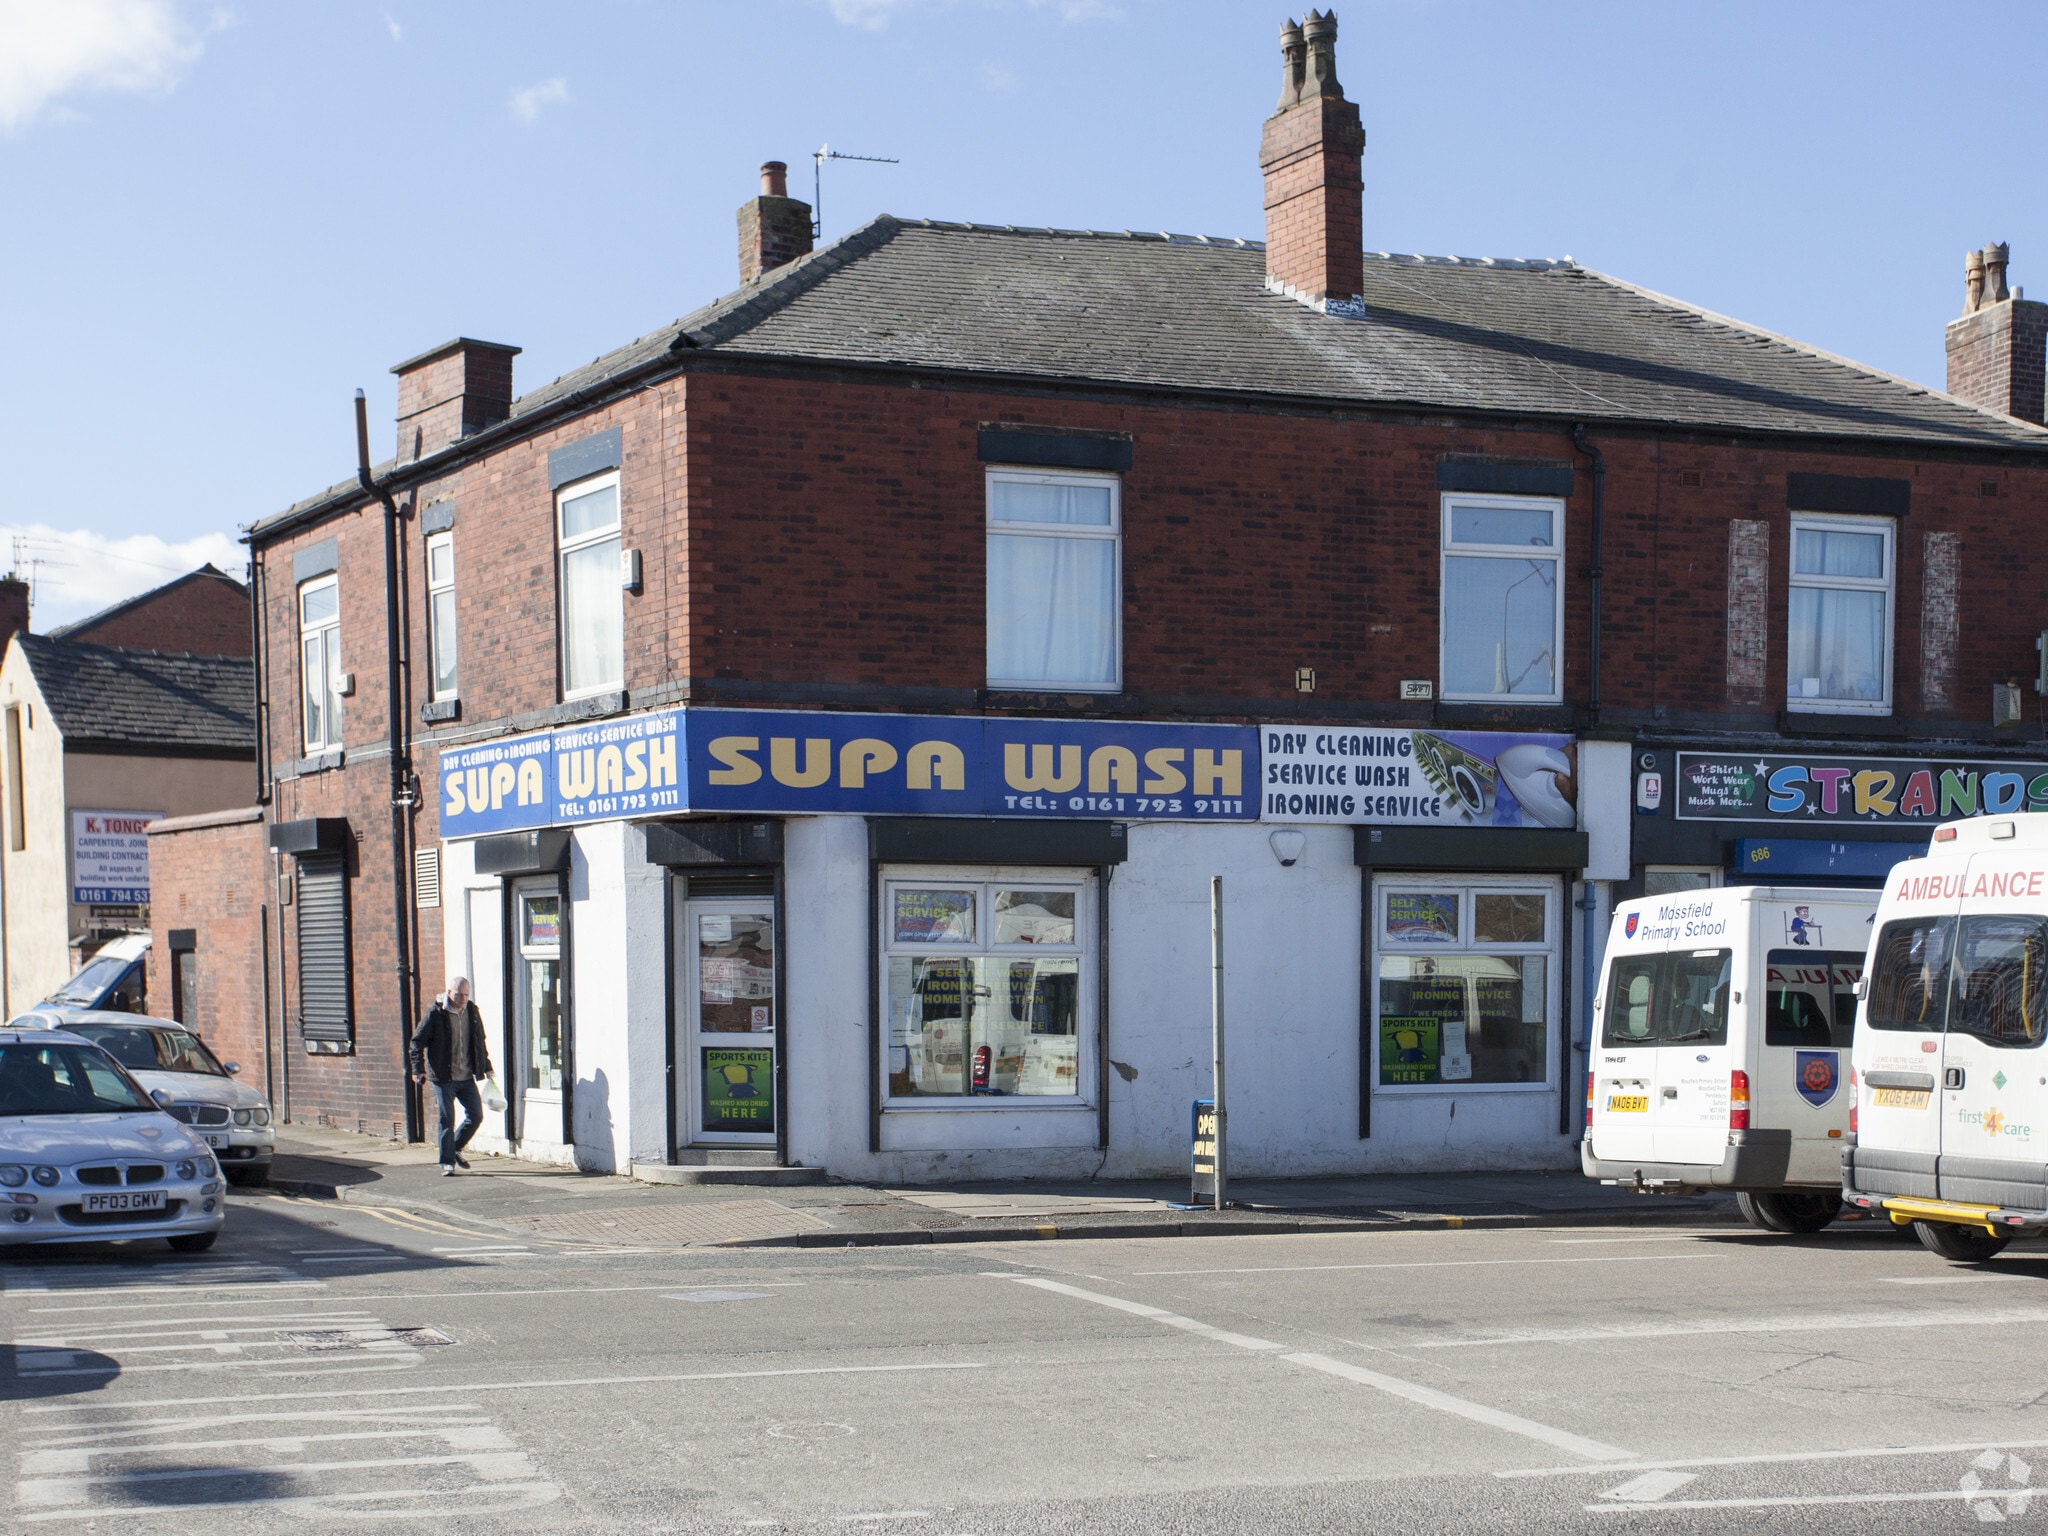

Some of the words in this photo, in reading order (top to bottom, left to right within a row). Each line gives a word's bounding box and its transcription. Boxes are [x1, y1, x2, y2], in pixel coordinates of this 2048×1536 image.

[443, 756, 459, 771] DRY
[461, 747, 503, 767] CLEANING
[510, 739, 550, 759] IRONING
[554, 731, 594, 751] SERVICE
[600, 723, 643, 743] SERVICE
[646, 716, 677, 735] WASH
[1268, 733, 1307, 754] DRY
[1316, 734, 1412, 757] CLEANING
[708, 736, 965, 791] SUPA
[1004, 743, 1242, 796] WASH
[1699, 764, 1743, 774] T-Shirts
[445, 758, 543, 816] SUPA
[558, 735, 677, 800] WASH
[1268, 763, 1346, 785] SERVICE
[1355, 765, 1410, 787] WASH
[1692, 775, 1718, 785] Work
[1723, 776, 1750, 785] Wear
[1701, 787, 1729, 797] Mugs
[1733, 787, 1740, 796] &
[559, 802, 584, 817] TEL:
[588, 797, 617, 814] 0161
[621, 793, 646, 810] 793
[651, 790, 678, 806] 9111
[1005, 795, 1057, 810] TEL:
[1069, 797, 1125, 812] 0161
[1136, 799, 1182, 813] 793
[1194, 799, 1243, 814] 9111
[1268, 793, 1355, 816] IRONING
[1364, 795, 1440, 817] SERVICE
[1688, 796, 1715, 806] Much
[1720, 797, 1753, 806] More...
[86, 817, 101, 833] K.
[76, 851, 110, 860] BUILDING
[112, 852, 148, 861] CONTRACT
[1751, 847, 1770, 862] 686
[1896, 871, 2045, 902] AMBULANCE
[80, 890, 106, 901] 0161
[111, 890, 131, 901] 794
[134, 890, 150, 901] 53
[897, 894, 928, 905] SELF
[1390, 898, 1417, 908] SELF
[897, 906, 949, 918] SERVICE
[1390, 910, 1435, 921] SERVICE
[1641, 926, 1680, 940] Primary
[1685, 919, 1726, 937] School
[708, 965, 729, 976] OPEN
[936, 967, 991, 978] SERVICE
[997, 968, 1033, 978] WASH
[1431, 979, 1493, 987] EXCELLENT
[923, 994, 960, 1004] HOME
[1412, 991, 1459, 1000] IRONING
[1463, 990, 1511, 999] SERVICE
[991, 1021, 1044, 1031] SERVICE
[1383, 1019, 1416, 1028] SPORTS
[1417, 1019, 1436, 1027] KITS
[709, 1052, 745, 1061] SPORTS
[748, 1053, 768, 1061] KITS
[1393, 1071, 1426, 1081] HERE
[1611, 1096, 1631, 1109] NA06
[1632, 1097, 1648, 1109] BVT
[1878, 1090, 1901, 1104] YX06
[1903, 1091, 1925, 1106] EAM
[721, 1107, 758, 1118] HERE
[1959, 1108, 1983, 1124] first
[1197, 1114, 1215, 1135] OPE
[1986, 1115, 1997, 1132] 4
[2004, 1122, 2031, 1136] care
[89, 1194, 128, 1210] PF03
[132, 1193, 160, 1208] GMV
